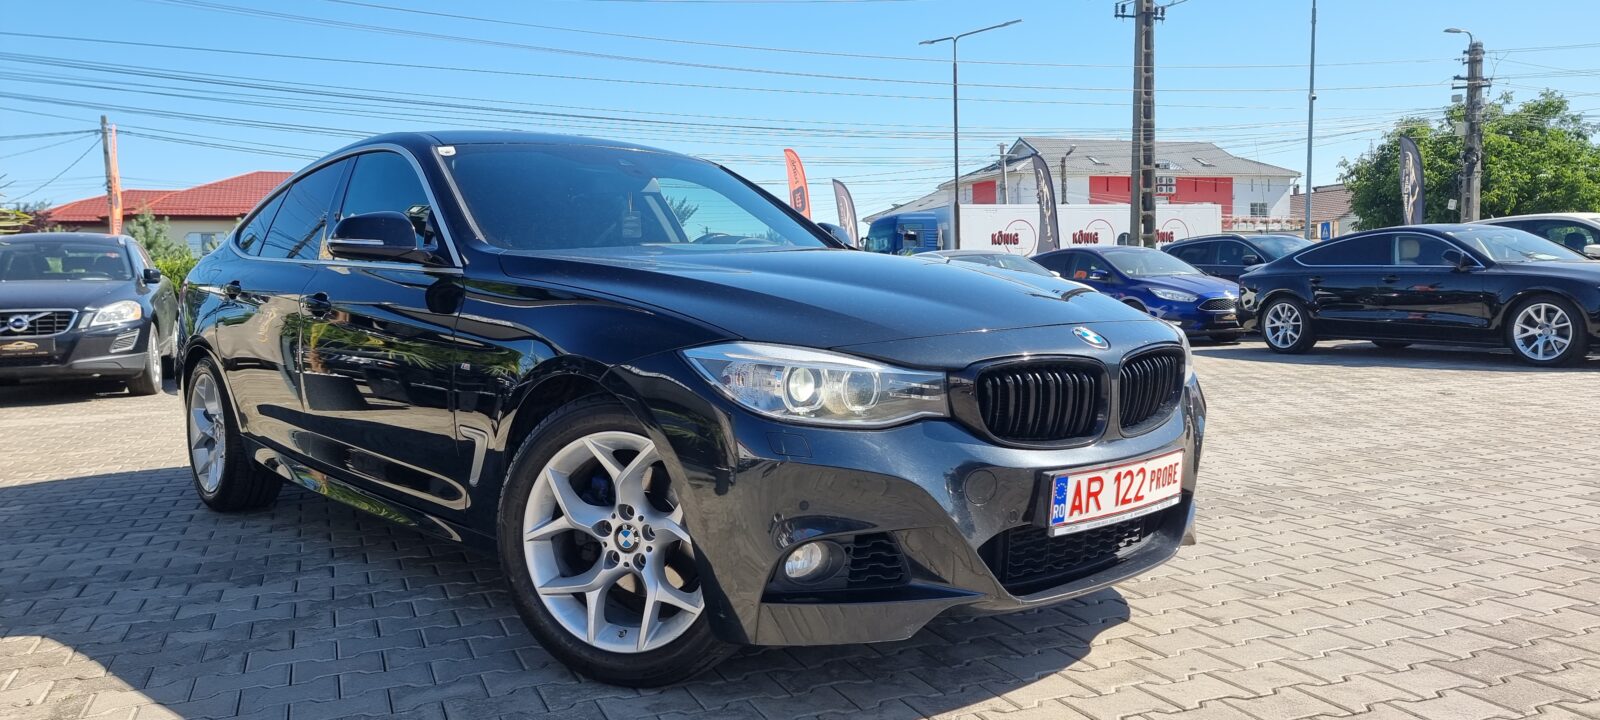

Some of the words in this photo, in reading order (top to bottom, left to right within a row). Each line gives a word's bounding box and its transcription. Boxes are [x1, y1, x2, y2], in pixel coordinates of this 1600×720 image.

[991, 230, 1019, 245] KÖNIG
[1072, 229, 1099, 245] KÖNIG
[1155, 229, 1174, 243] ÖNIG
[1068, 476, 1104, 517] AR
[1114, 468, 1146, 506] 122
[1149, 462, 1180, 492] PROBE
[1052, 503, 1065, 518] RO
